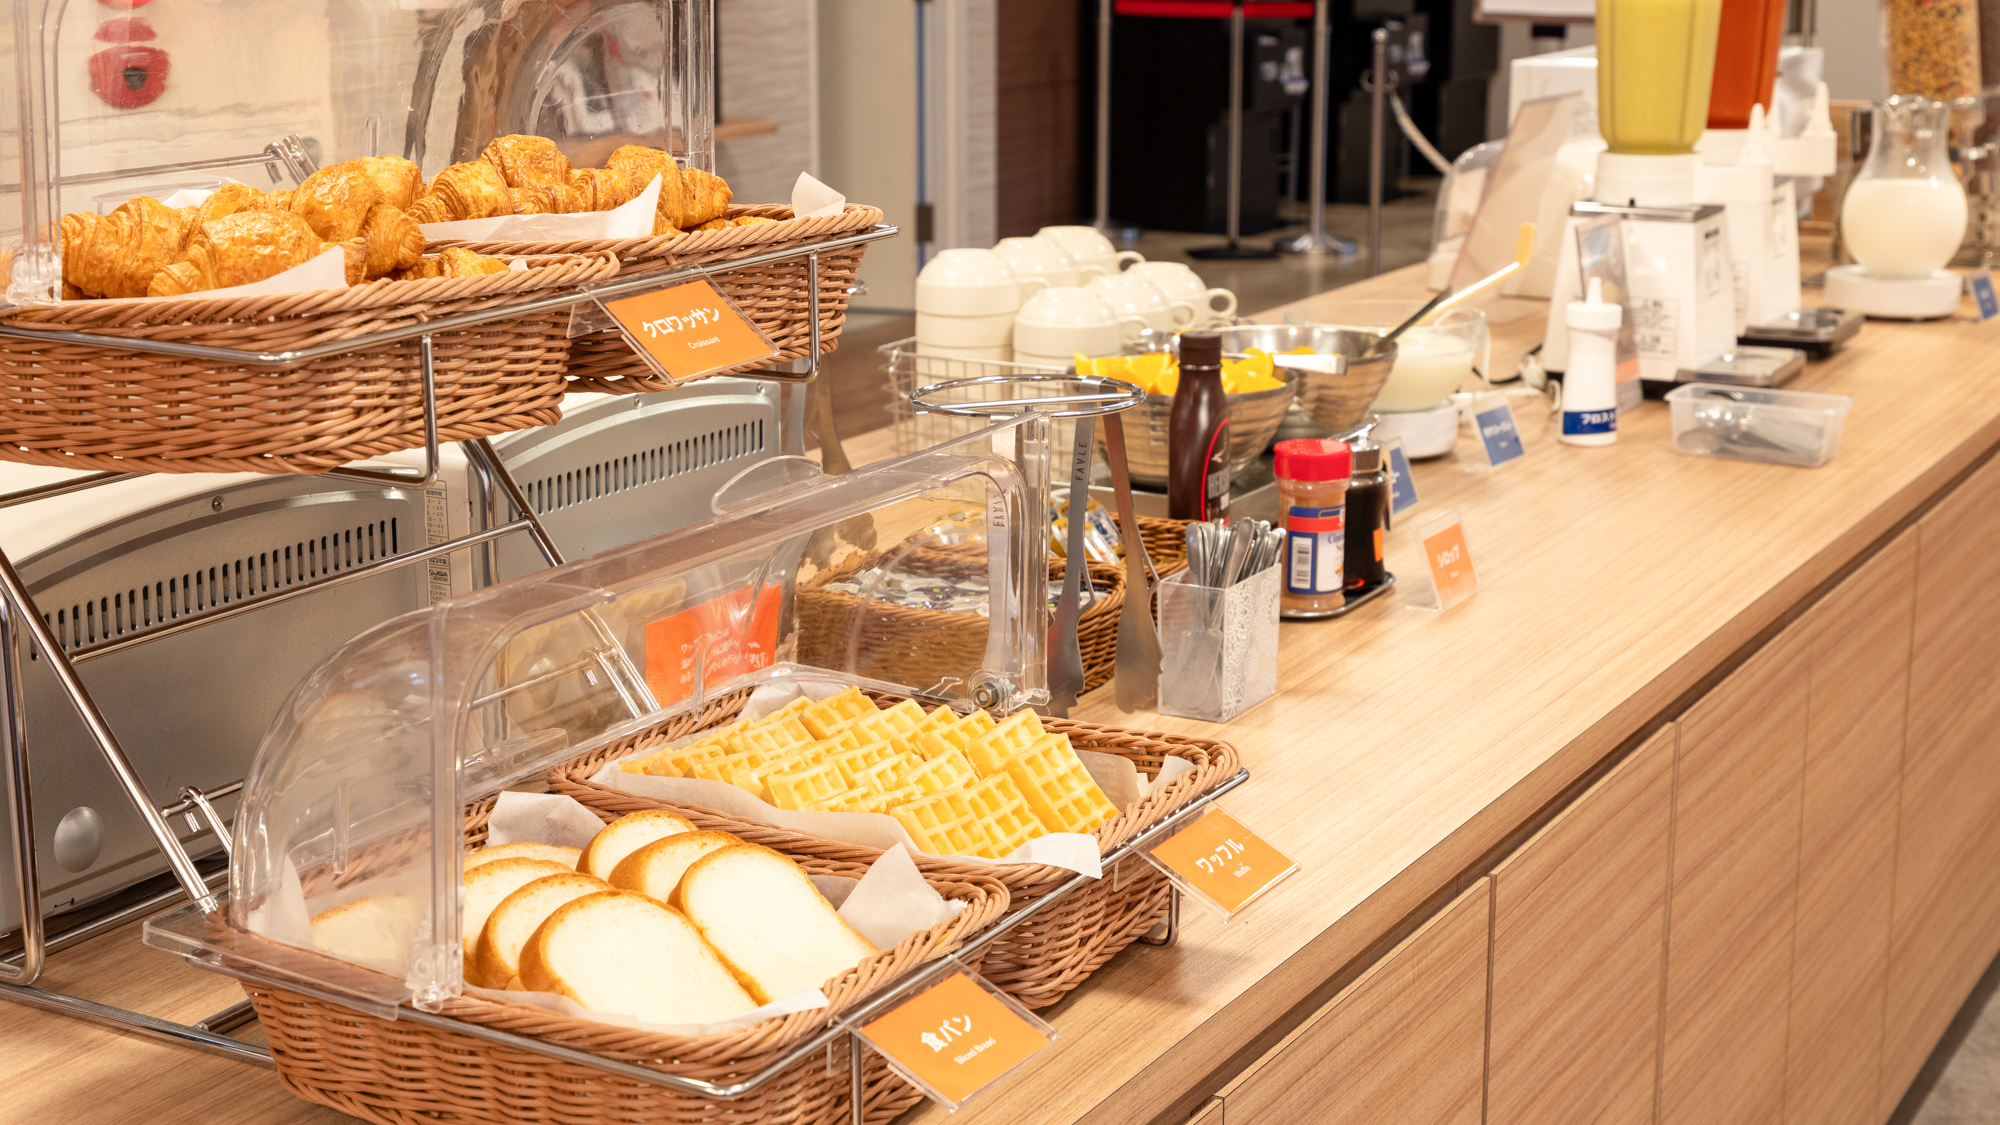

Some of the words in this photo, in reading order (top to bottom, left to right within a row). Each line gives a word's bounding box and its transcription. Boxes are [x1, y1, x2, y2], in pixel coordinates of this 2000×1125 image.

[642, 307, 720, 338] クロワッサン
[687, 336, 721, 349] Croissant
[1075, 442, 1088, 481] FAVLE
[1195, 838, 1245, 873] ワッフル
[920, 1014, 972, 1052] 食パン
[954, 1047, 978, 1065] Sliced
[973, 1036, 997, 1054] Bread
